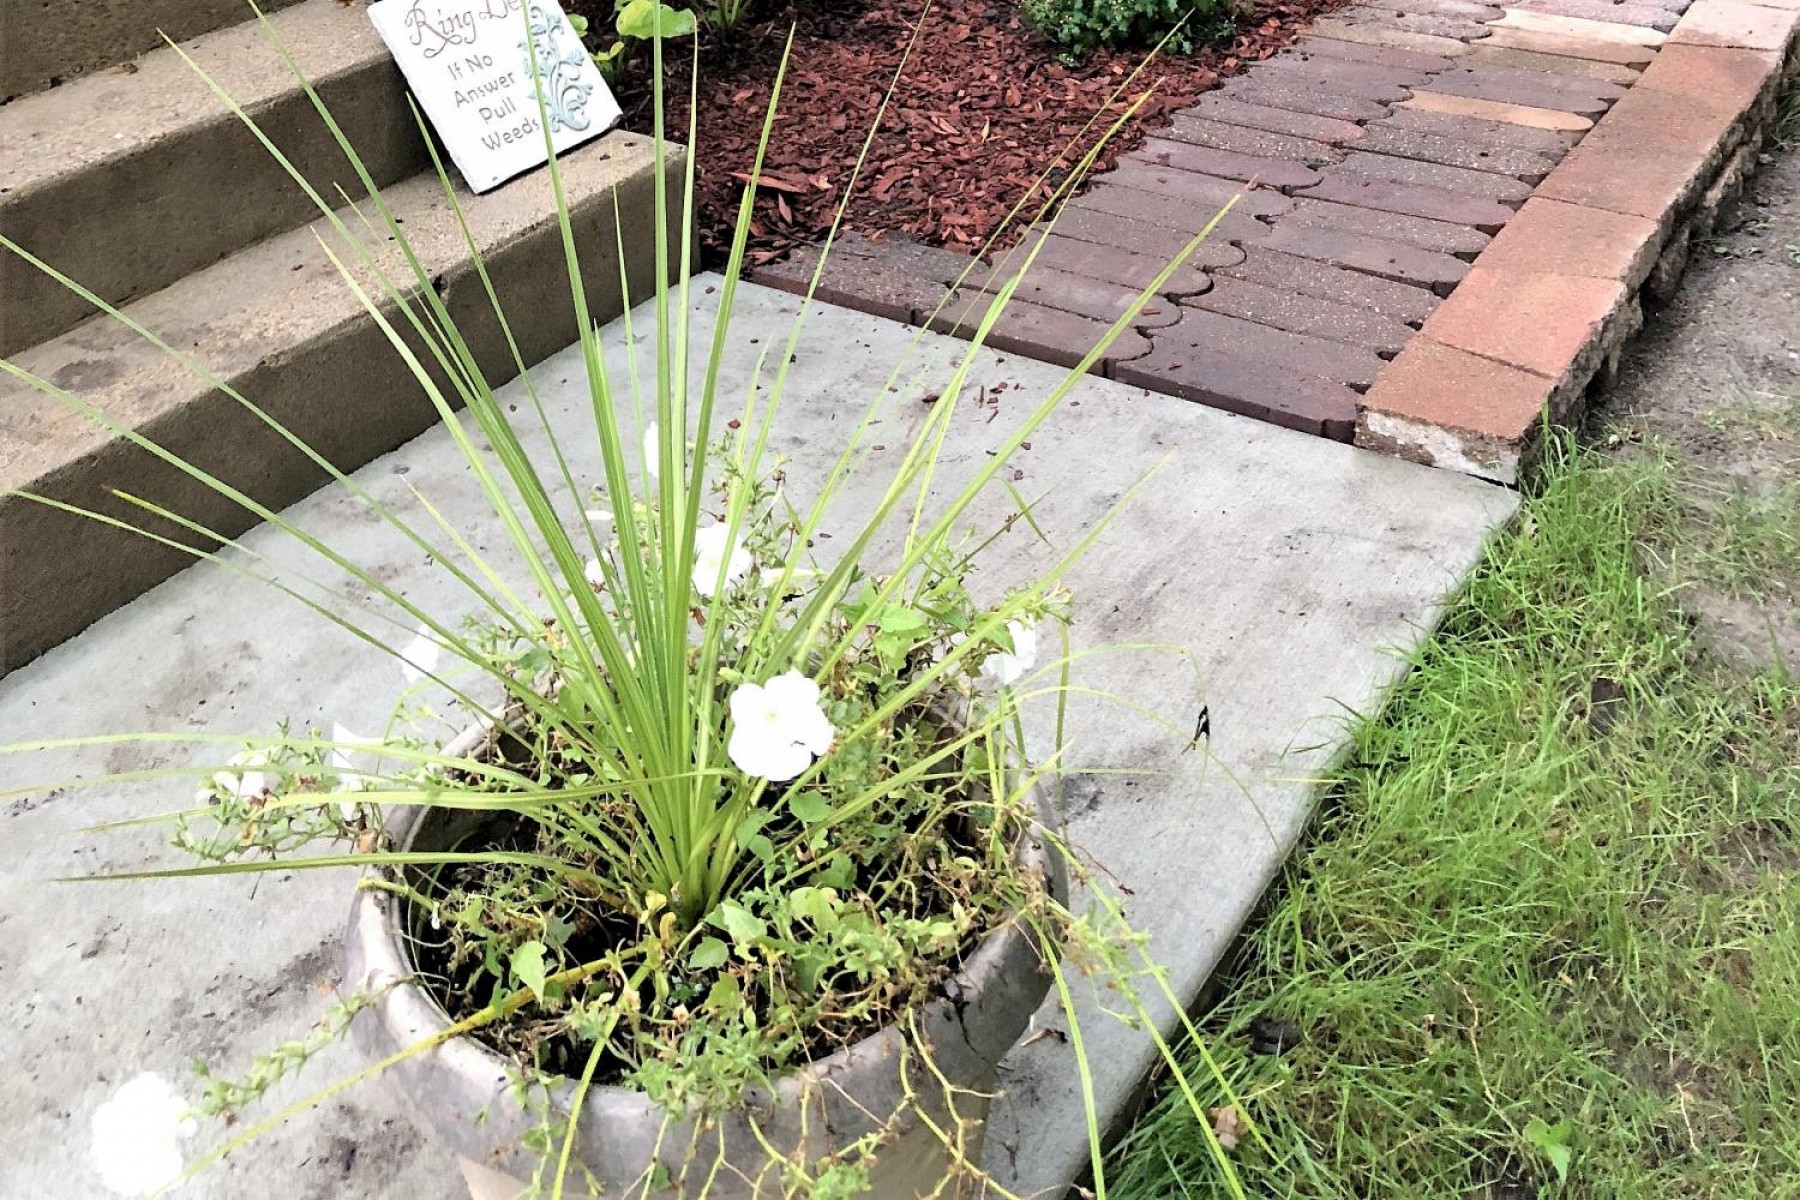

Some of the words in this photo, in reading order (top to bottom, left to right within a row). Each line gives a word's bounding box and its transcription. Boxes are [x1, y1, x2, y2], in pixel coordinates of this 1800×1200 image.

[404, 0, 476, 58] Ring
[447, 61, 464, 81] If
[465, 54, 493, 73] No
[454, 71, 515, 108] Answer
[478, 96, 517, 125] Pull
[481, 117, 540, 151] Weeds
